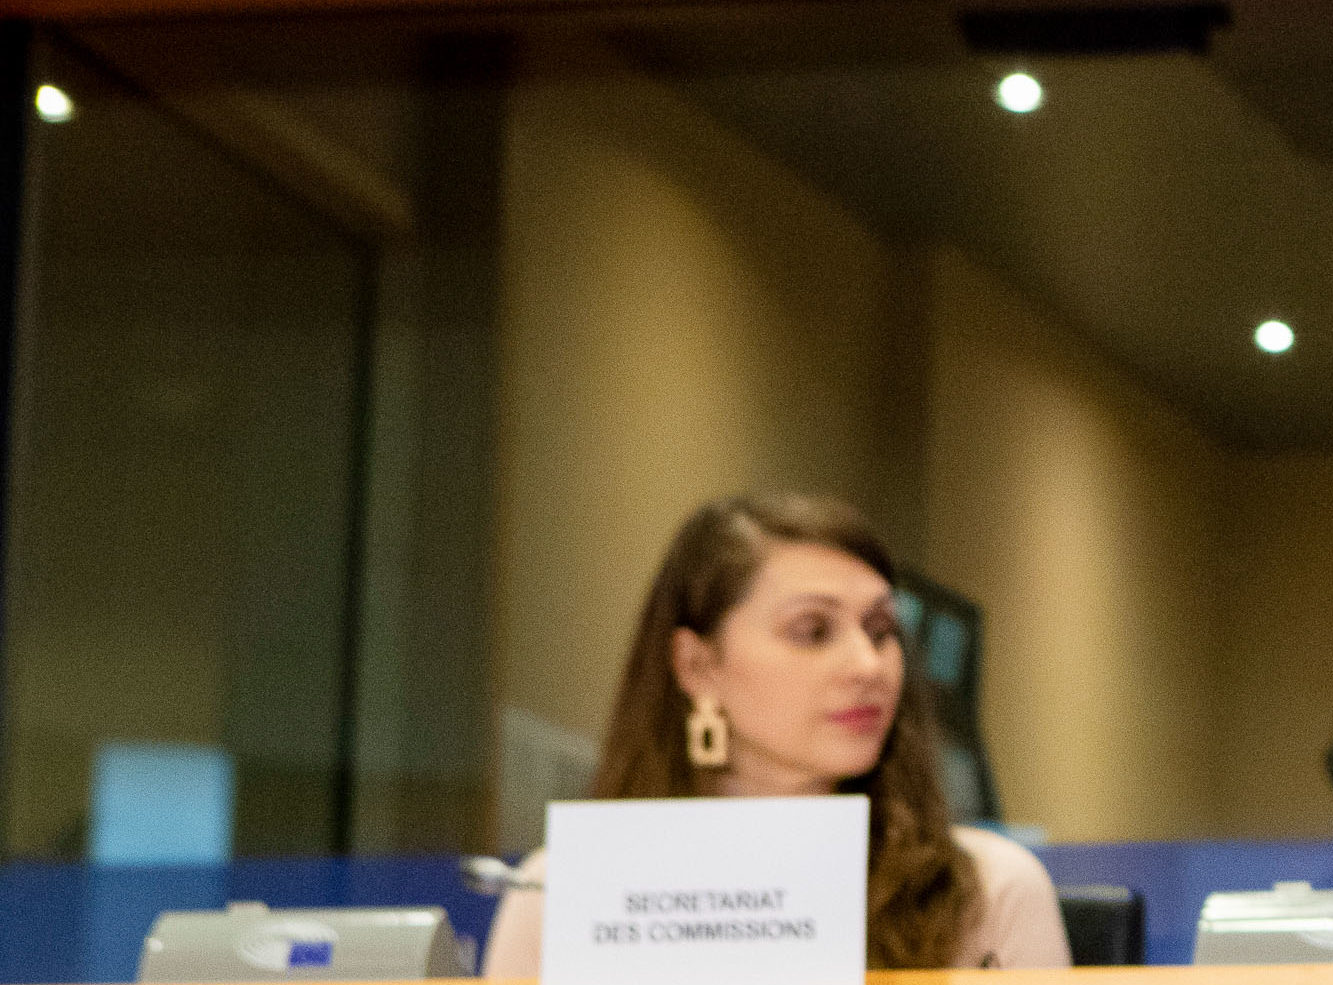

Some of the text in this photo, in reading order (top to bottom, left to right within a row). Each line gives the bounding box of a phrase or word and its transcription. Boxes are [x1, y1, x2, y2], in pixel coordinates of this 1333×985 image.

[625, 889, 785, 914] SECRETARIAT
[594, 918, 817, 944] DES COMMISSIONS
